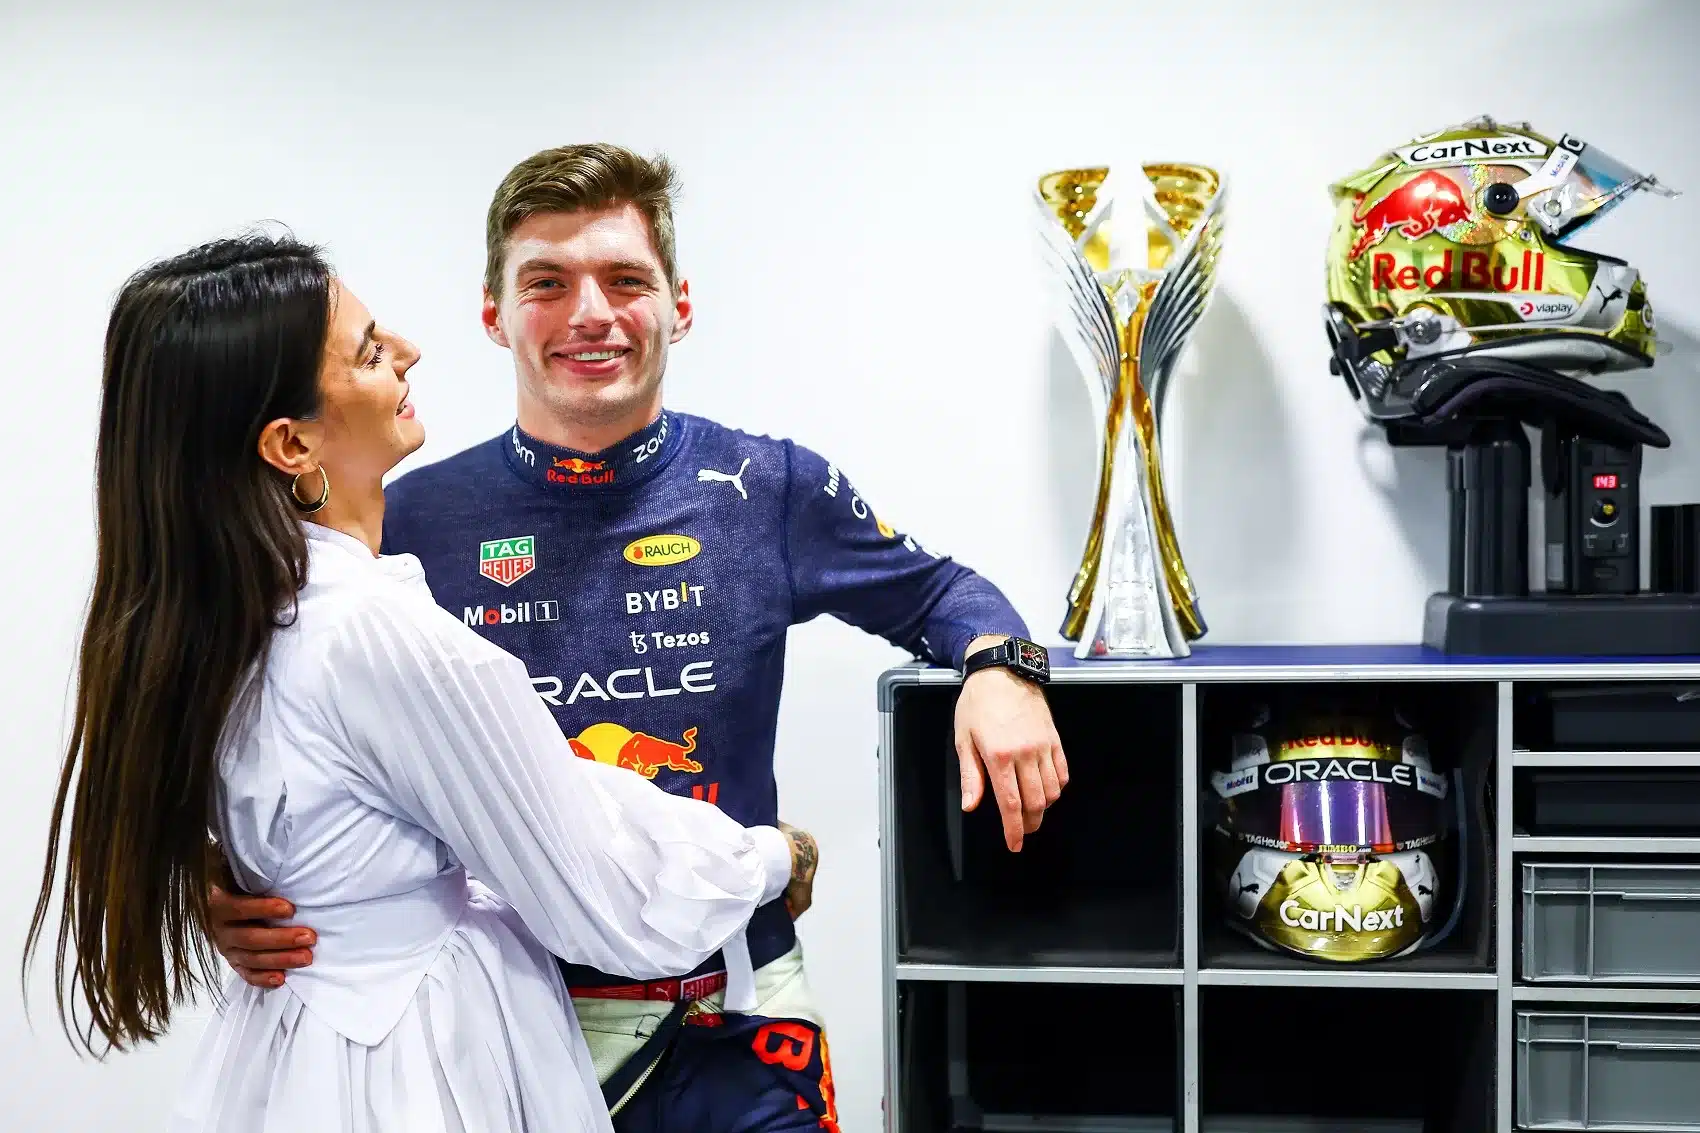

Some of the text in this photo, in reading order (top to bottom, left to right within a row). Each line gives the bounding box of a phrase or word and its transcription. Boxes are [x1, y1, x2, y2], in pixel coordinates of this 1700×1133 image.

[1410, 140, 1536, 163] CarNext
[1373, 249, 1545, 291] Red Bull
[546, 468, 616, 485] Red Bull
[484, 539, 530, 556] TAG
[644, 542, 691, 558] RAUCH
[483, 559, 533, 585] HEUER
[625, 581, 705, 614] BYBIT
[463, 601, 530, 626] Mobil
[651, 630, 711, 650] Tezos
[529, 660, 717, 706] RACLE
[1264, 759, 1412, 787] ORACLE
[1279, 900, 1404, 932] CarNext
